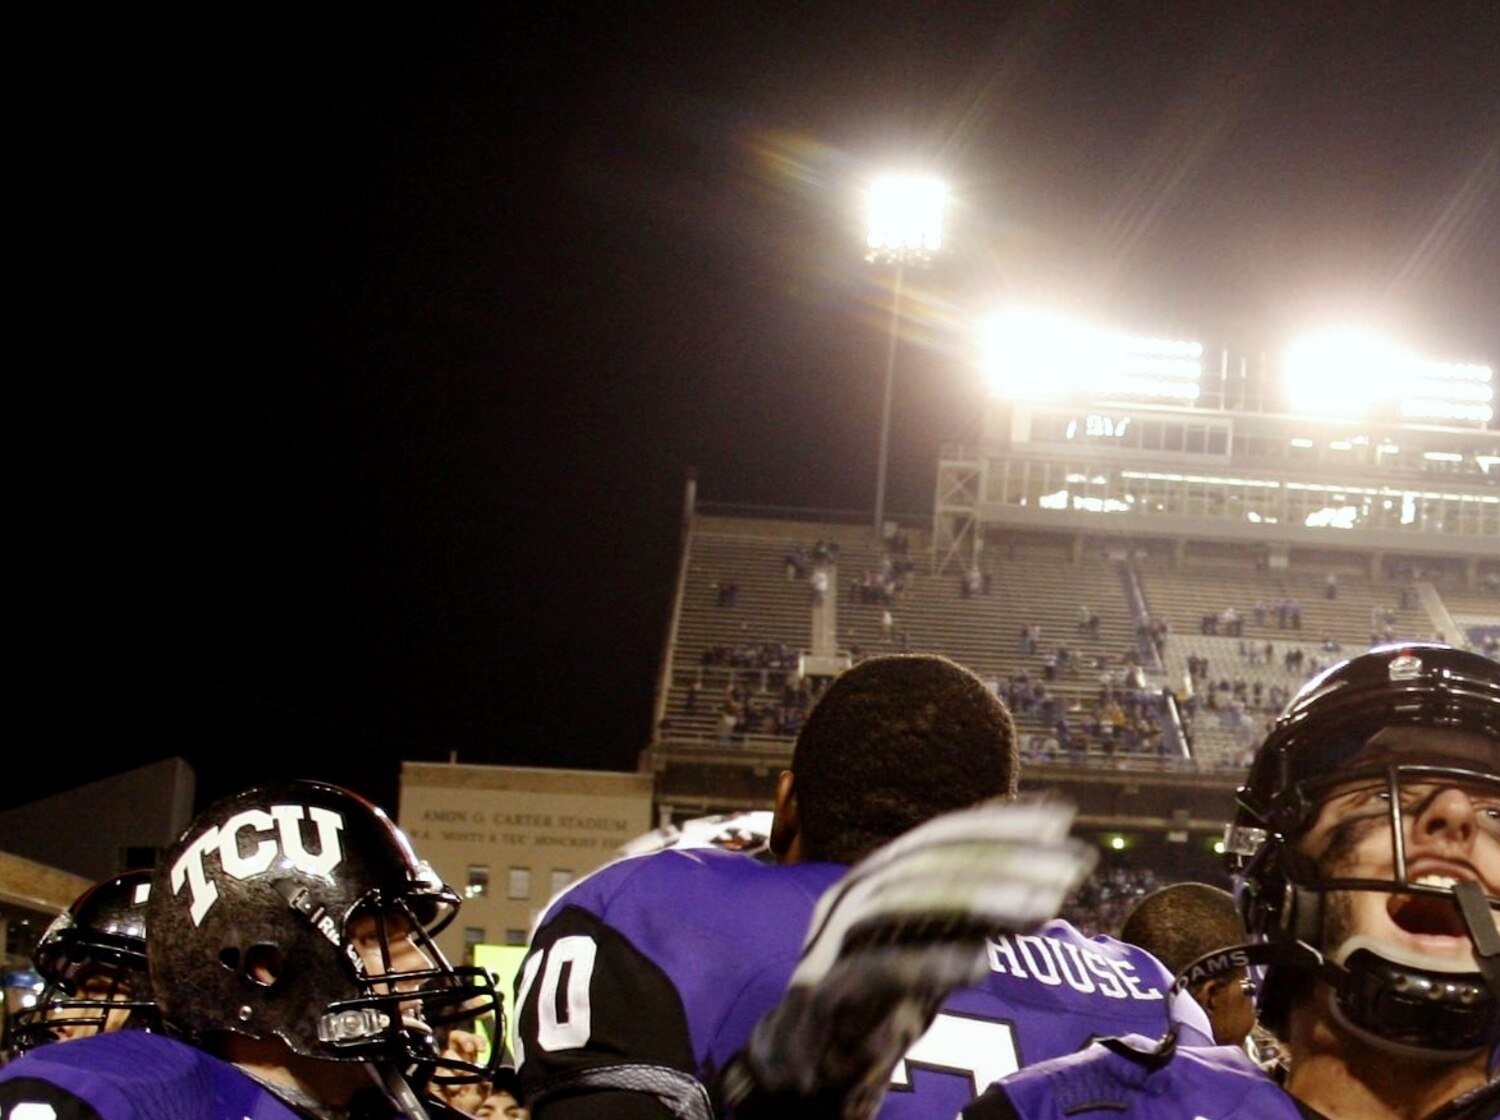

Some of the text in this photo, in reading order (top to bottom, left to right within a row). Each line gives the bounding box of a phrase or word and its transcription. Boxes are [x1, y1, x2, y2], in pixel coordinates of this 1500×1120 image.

[493, 811, 553, 827] CARTER
[559, 814, 628, 832] STADIUM
[171, 805, 344, 927] TCU
[985, 934, 1164, 1001] HOUSE
